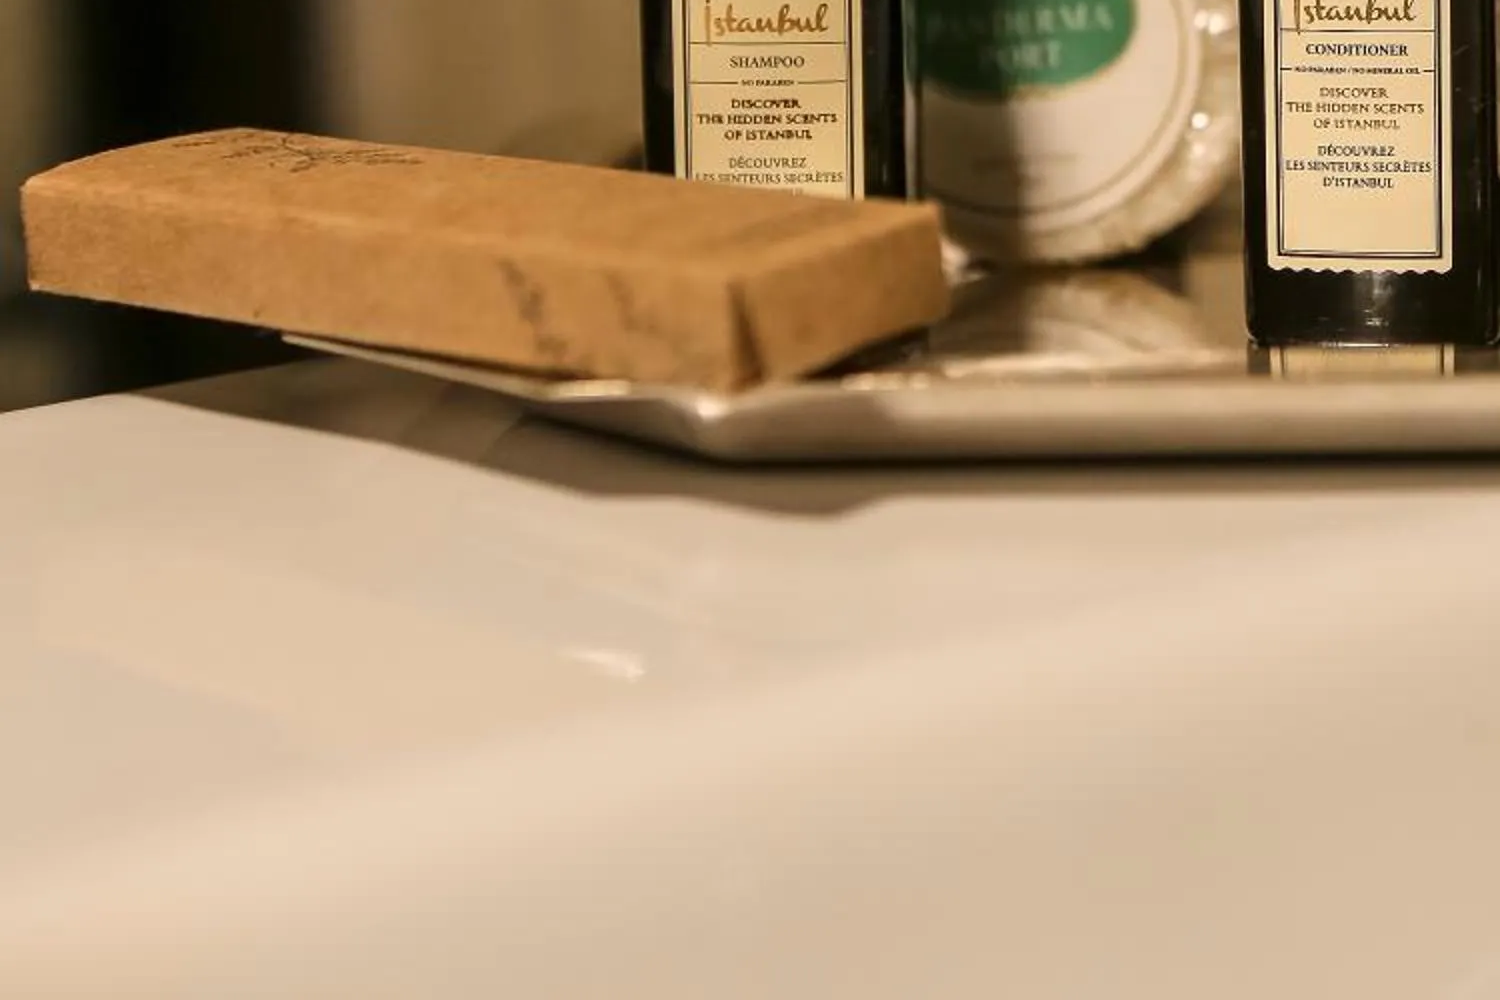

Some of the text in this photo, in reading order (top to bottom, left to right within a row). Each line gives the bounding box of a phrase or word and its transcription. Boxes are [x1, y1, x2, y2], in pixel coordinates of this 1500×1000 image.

[1305, 43, 1409, 56] CONDITIONER
[729, 55, 806, 69] SHAMPOO
[1319, 87, 1389, 99] DISCOVER
[731, 98, 802, 109] DISCOVER
[1286, 101, 1425, 114] THE HIDDEN SCENTS
[696, 113, 838, 125] THE HIDDEN SCENTS
[1313, 118, 1401, 130] OF ISTANBUL
[724, 129, 813, 141] OF ISTANBUL
[1317, 143, 1396, 157] DÉCOUVREZ
[728, 156, 807, 169] DÉCOUVREZ
[1286, 160, 1433, 173] LES SENTEURS SECRÈTES
[718, 172, 781, 184] SENTEURS
[783, 170, 844, 184] SECRÈTES
[1323, 176, 1394, 189] D'ISTANBUL
